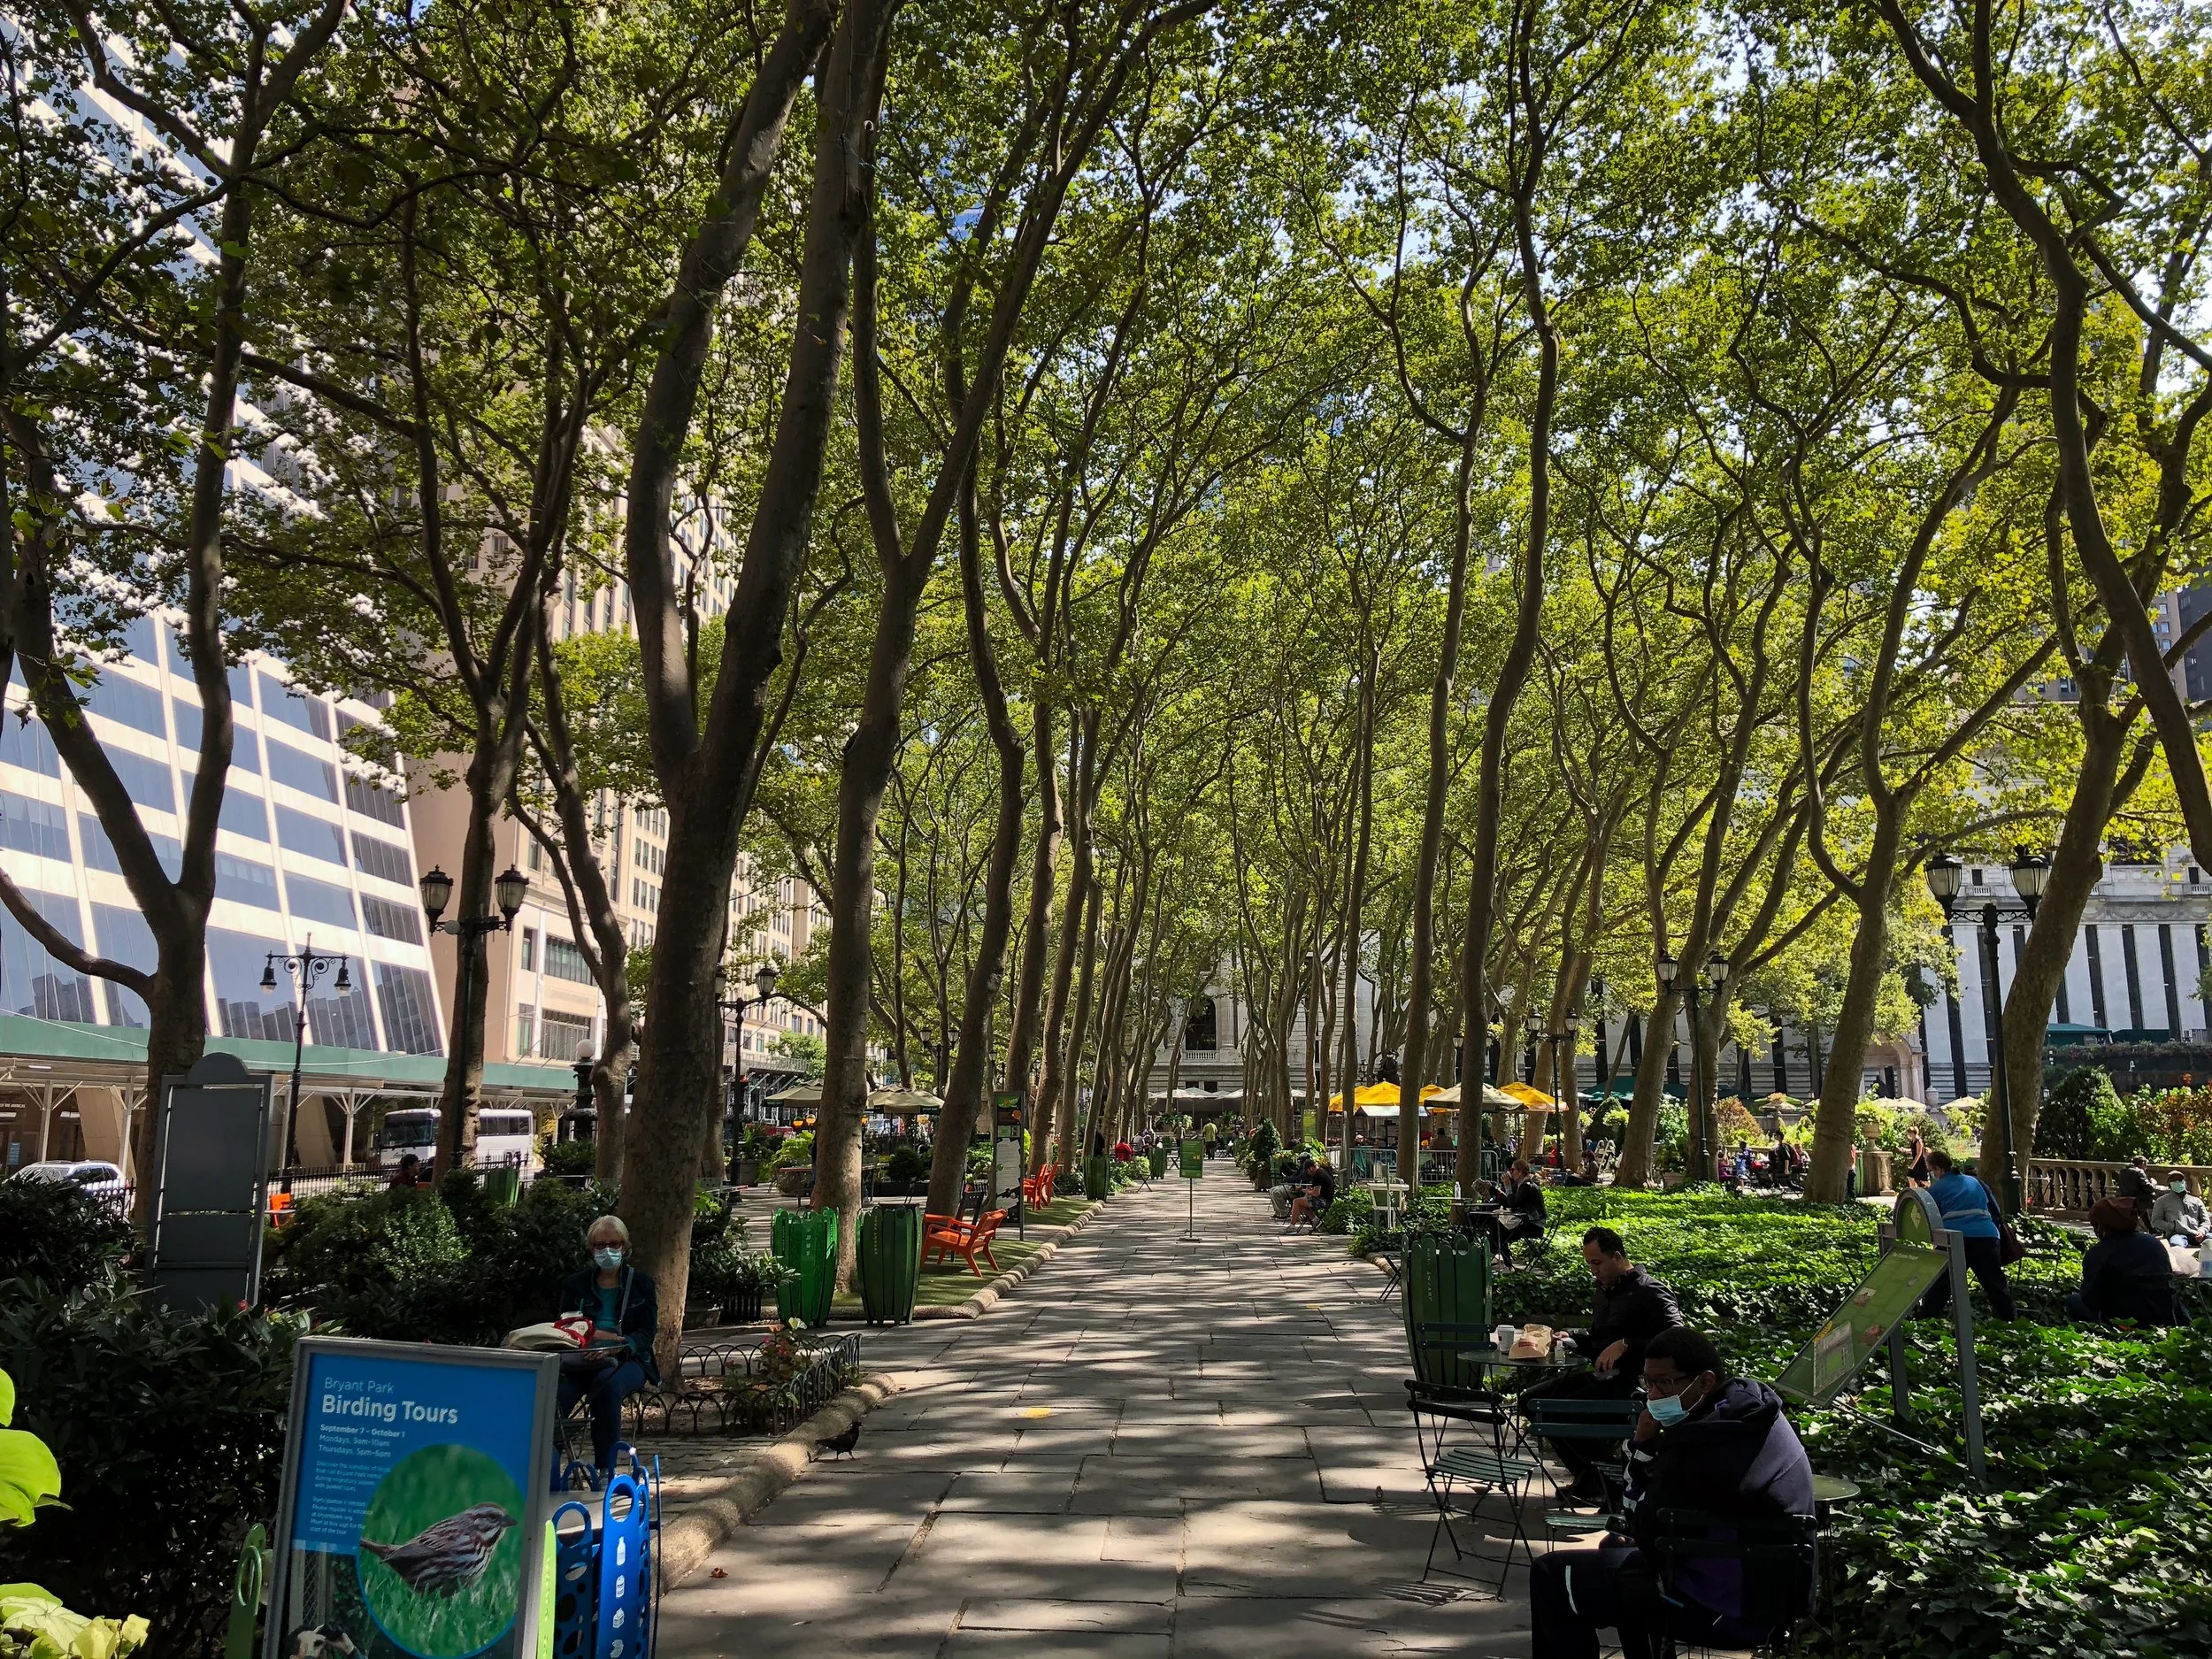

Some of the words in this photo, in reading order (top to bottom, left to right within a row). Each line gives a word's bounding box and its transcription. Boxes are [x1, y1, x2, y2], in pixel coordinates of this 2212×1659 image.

[324, 1377, 364, 1393] Bryant
[367, 1380, 395, 1394] Park
[322, 1394, 397, 1423] Birding
[401, 1400, 458, 1424] Tours
[320, 1424, 359, 1433] September
[371, 1428, 402, 1438] October
